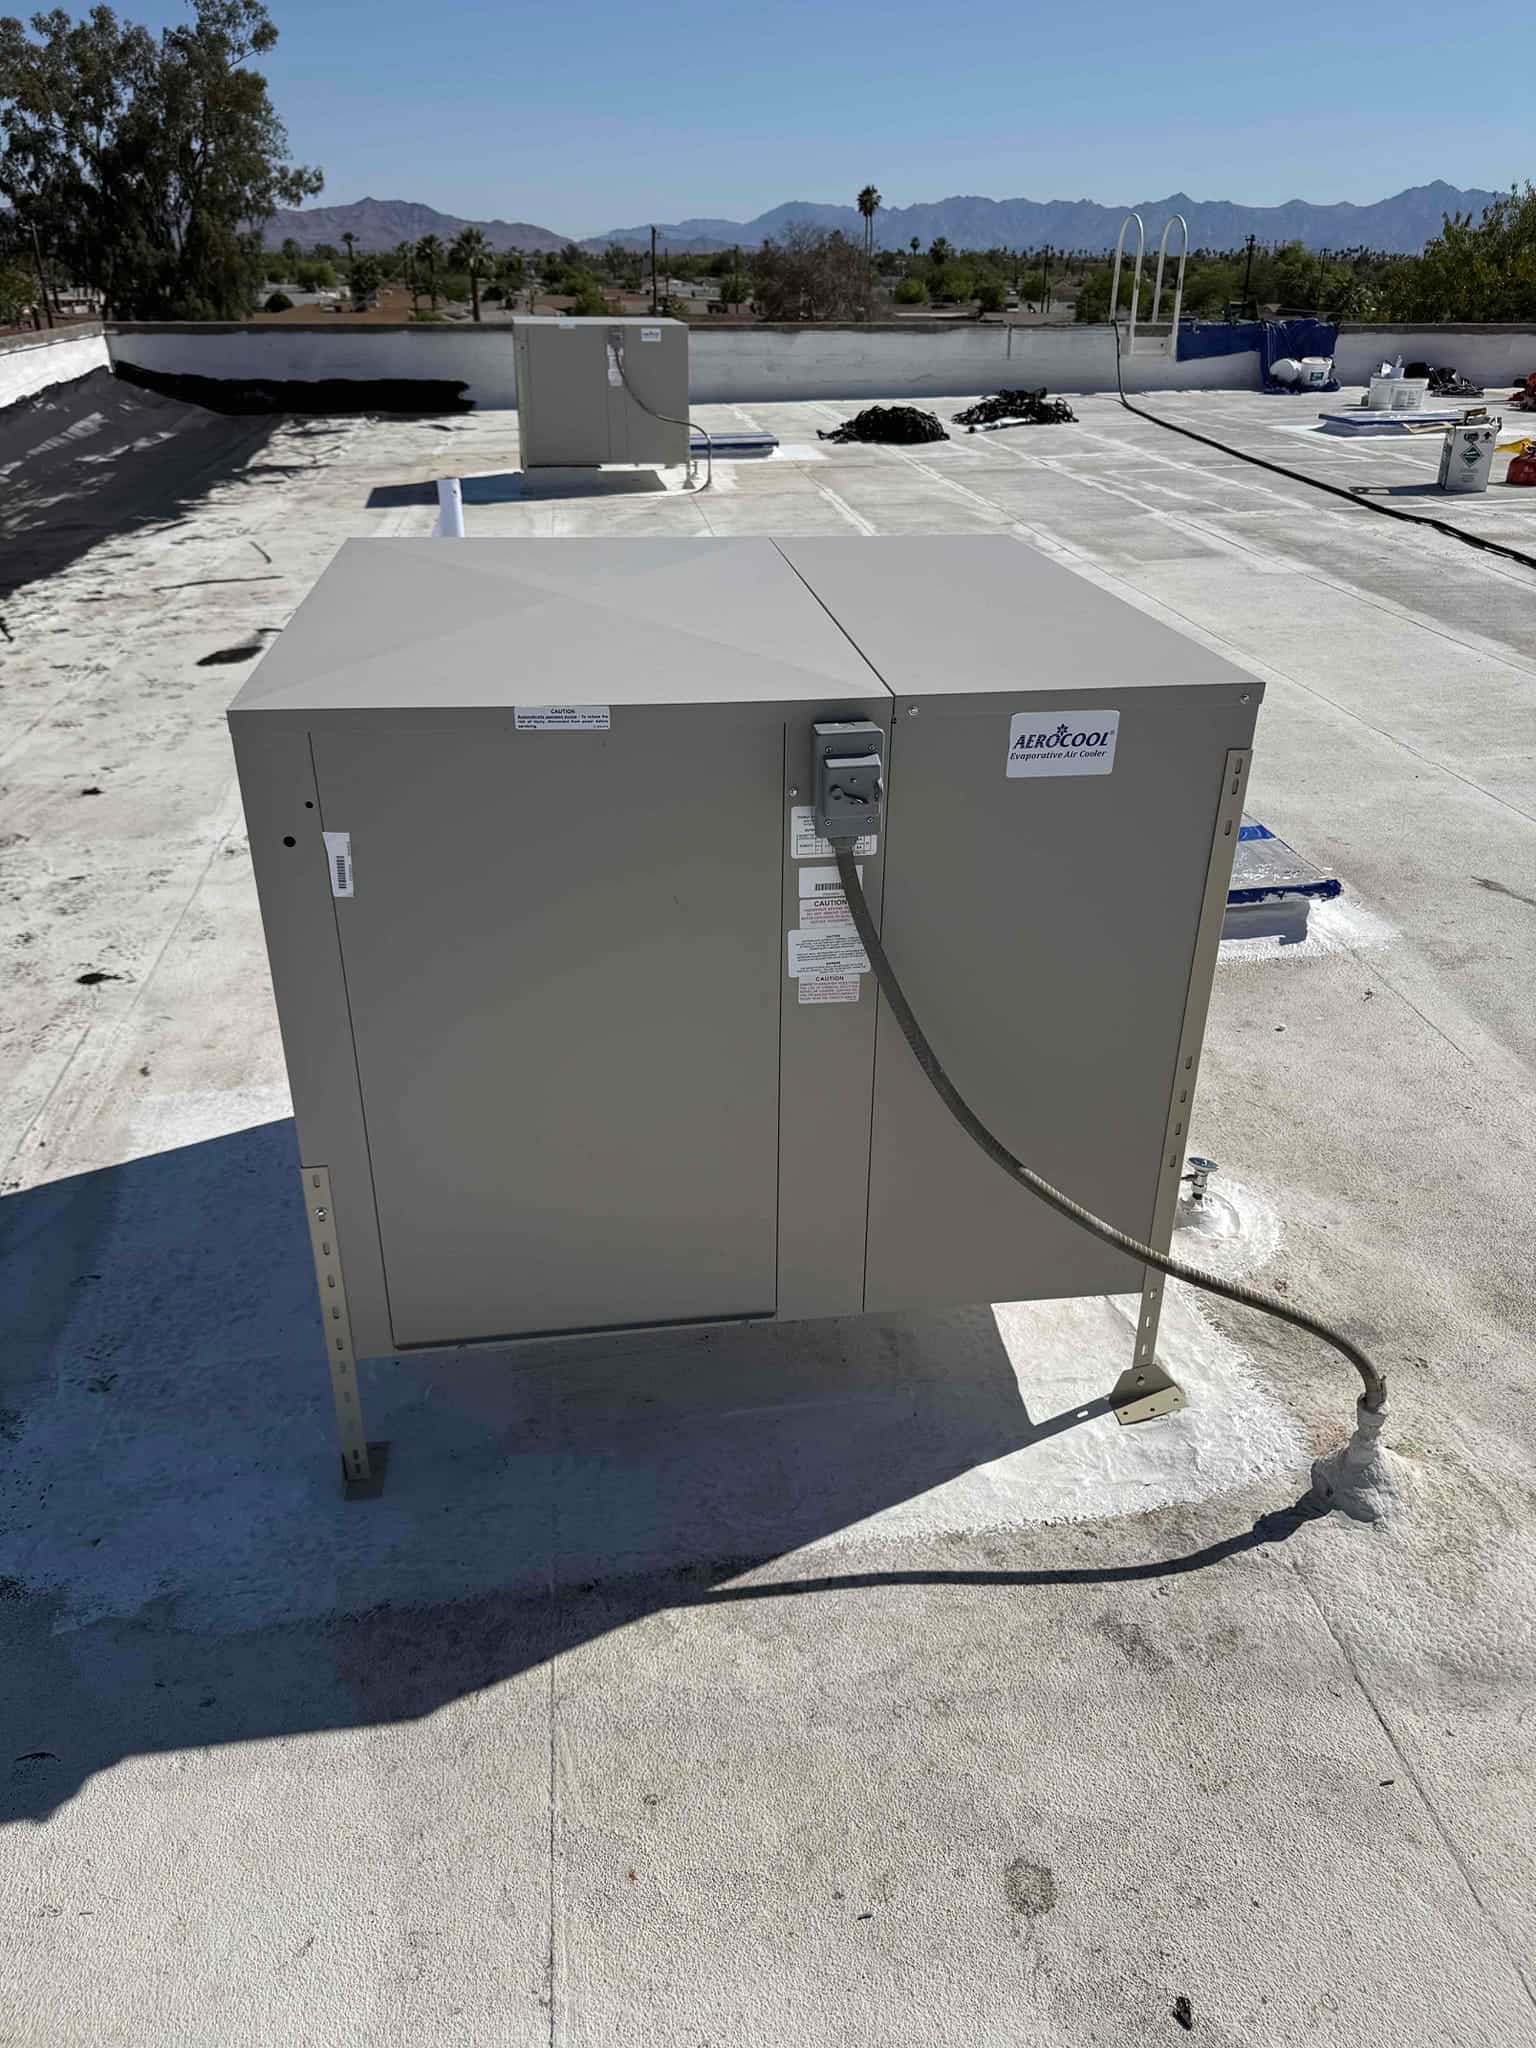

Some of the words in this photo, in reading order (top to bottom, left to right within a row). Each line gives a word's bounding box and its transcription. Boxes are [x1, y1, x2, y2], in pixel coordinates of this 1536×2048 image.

[1010, 752, 1063, 762] Evaporative
[1064, 751, 1078, 759] Air
[1079, 749, 1106, 759] Cooler
